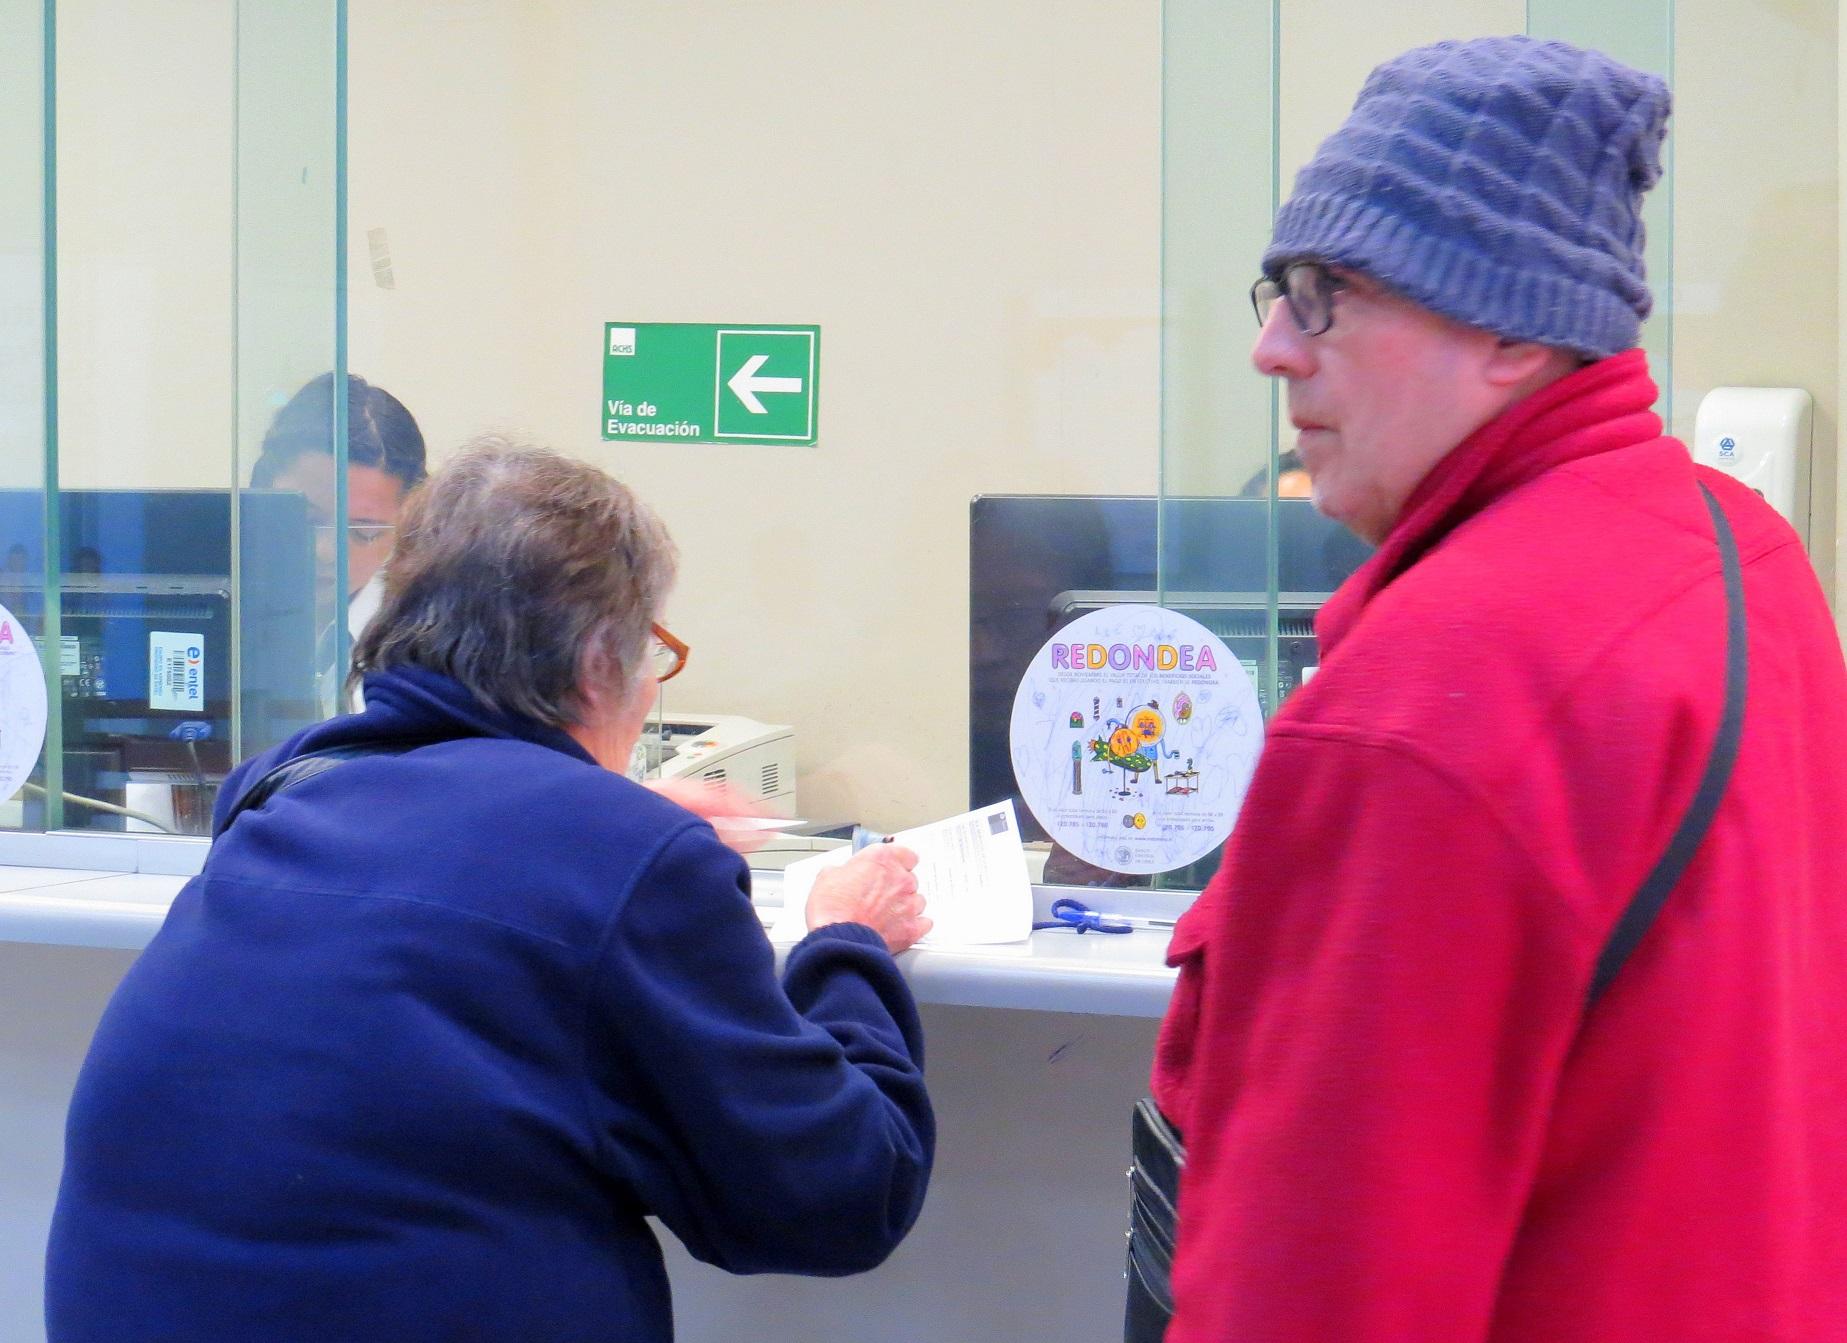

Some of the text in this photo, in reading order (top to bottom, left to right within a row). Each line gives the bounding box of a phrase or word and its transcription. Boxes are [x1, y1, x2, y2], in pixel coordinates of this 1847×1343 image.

[607, 400, 657, 417] Vía de
[607, 419, 700, 437] Evacuación
[1051, 643, 1217, 671] REDONDEA
[188, 667, 199, 700] entel
